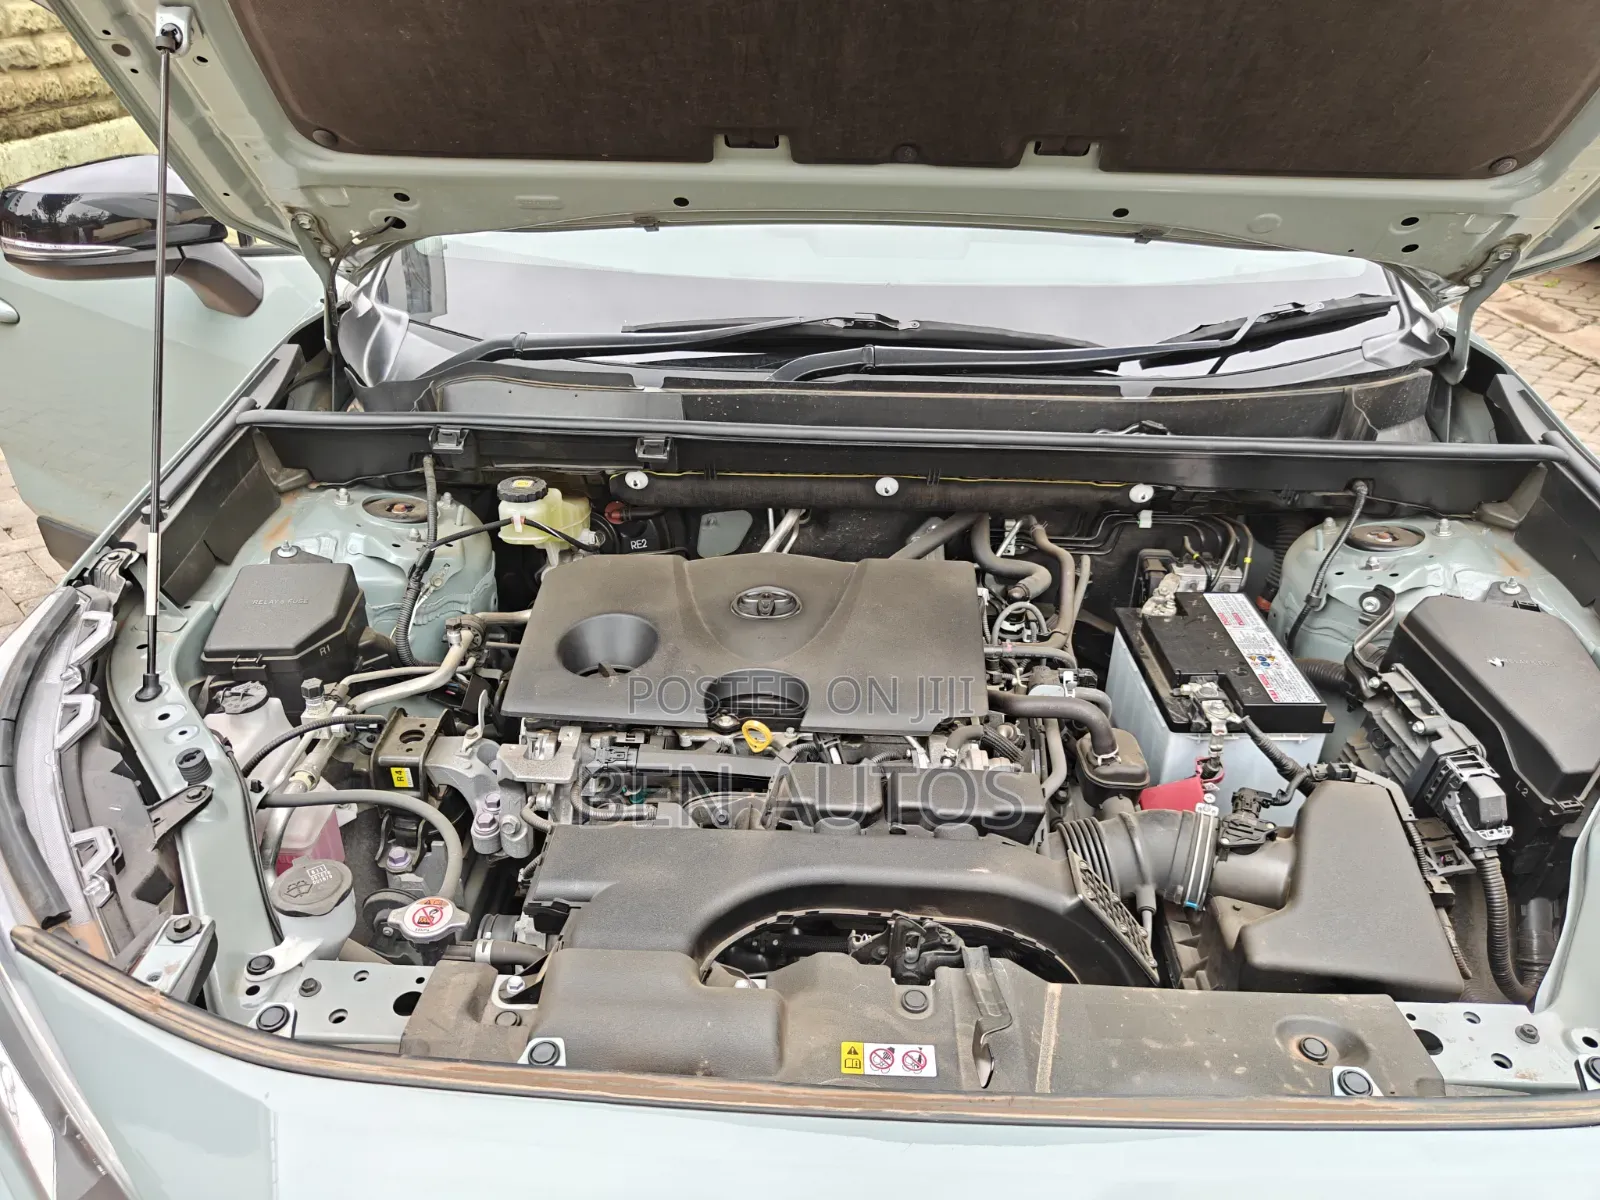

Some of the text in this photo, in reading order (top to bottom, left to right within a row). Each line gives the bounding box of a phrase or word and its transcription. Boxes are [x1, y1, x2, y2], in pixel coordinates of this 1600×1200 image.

[630, 538, 648, 550] RE2
[319, 644, 331, 656] R1
[1515, 780, 1529, 798] L2
